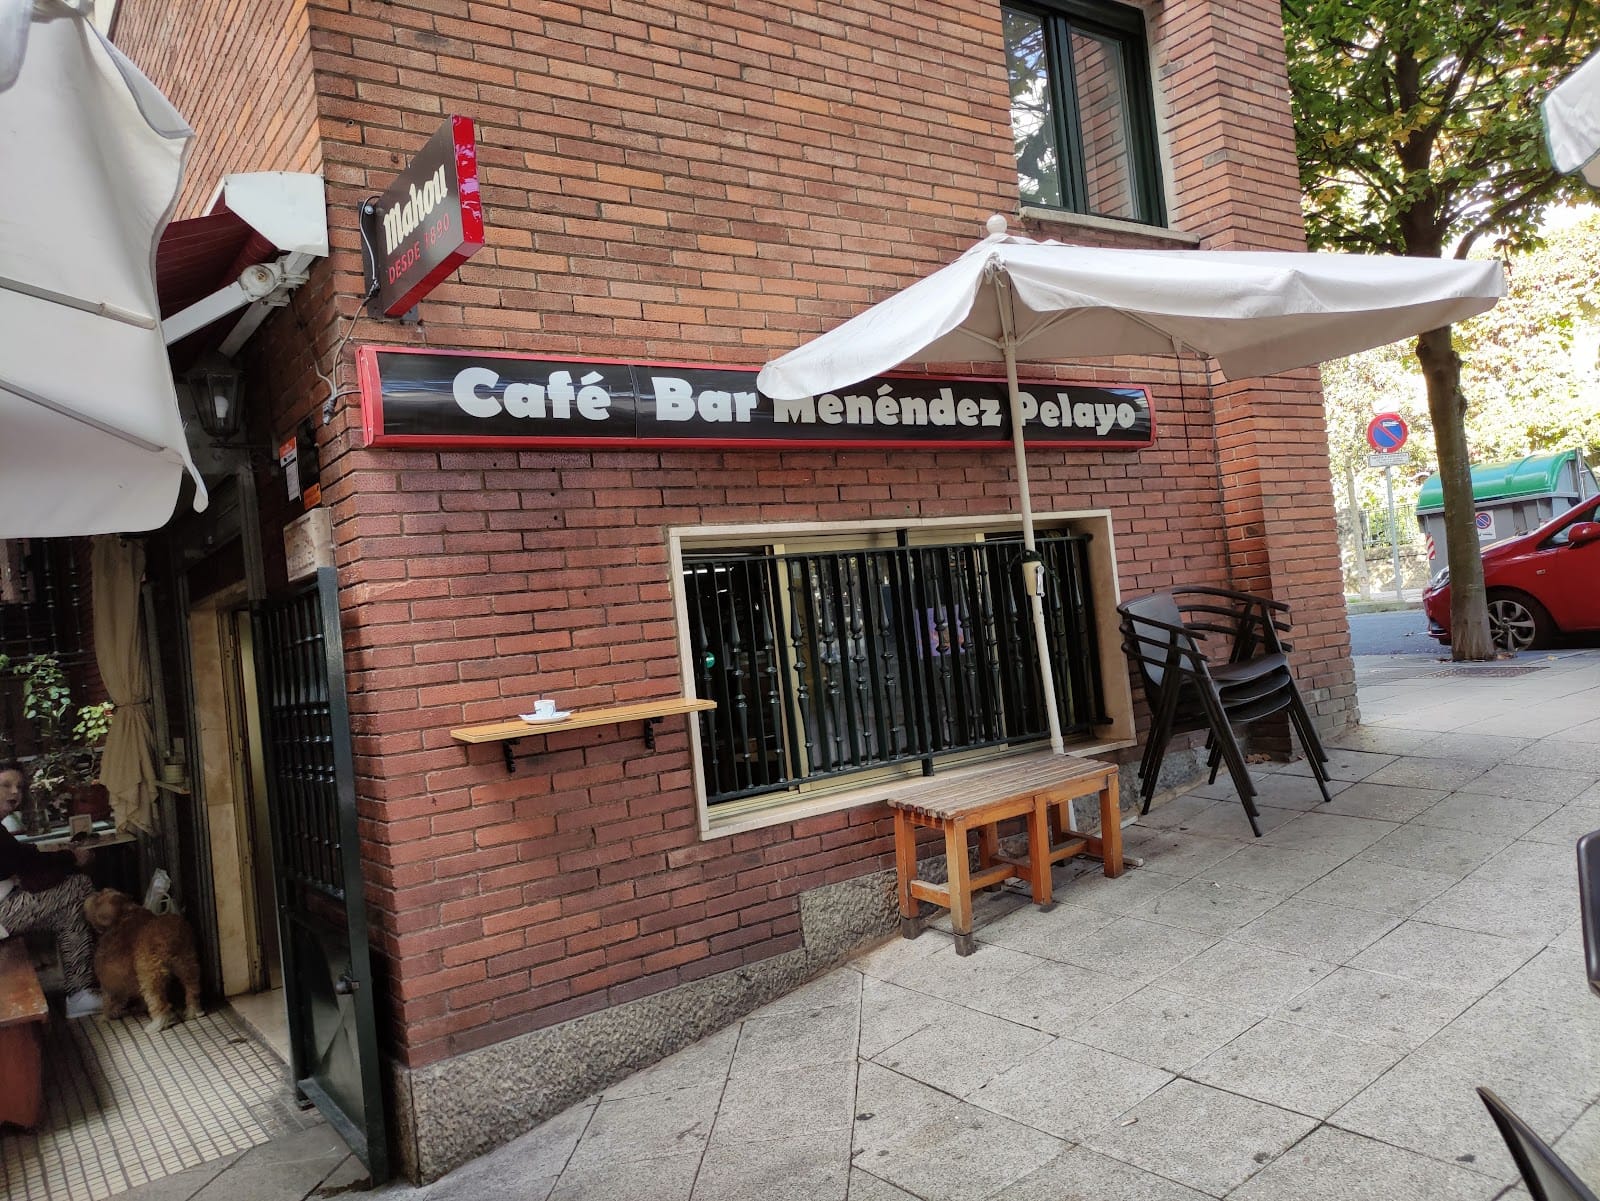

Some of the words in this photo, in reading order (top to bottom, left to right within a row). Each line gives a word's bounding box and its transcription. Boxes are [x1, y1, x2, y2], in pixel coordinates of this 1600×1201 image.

[383, 164, 448, 255] Mahou
[388, 241, 421, 285] DESDE
[424, 213, 450, 249] 1890
[452, 366, 611, 420] Café
[651, 376, 757, 422] Bar
[773, 384, 1002, 427] Menéndez
[1017, 391, 1136, 436] Pelayo
